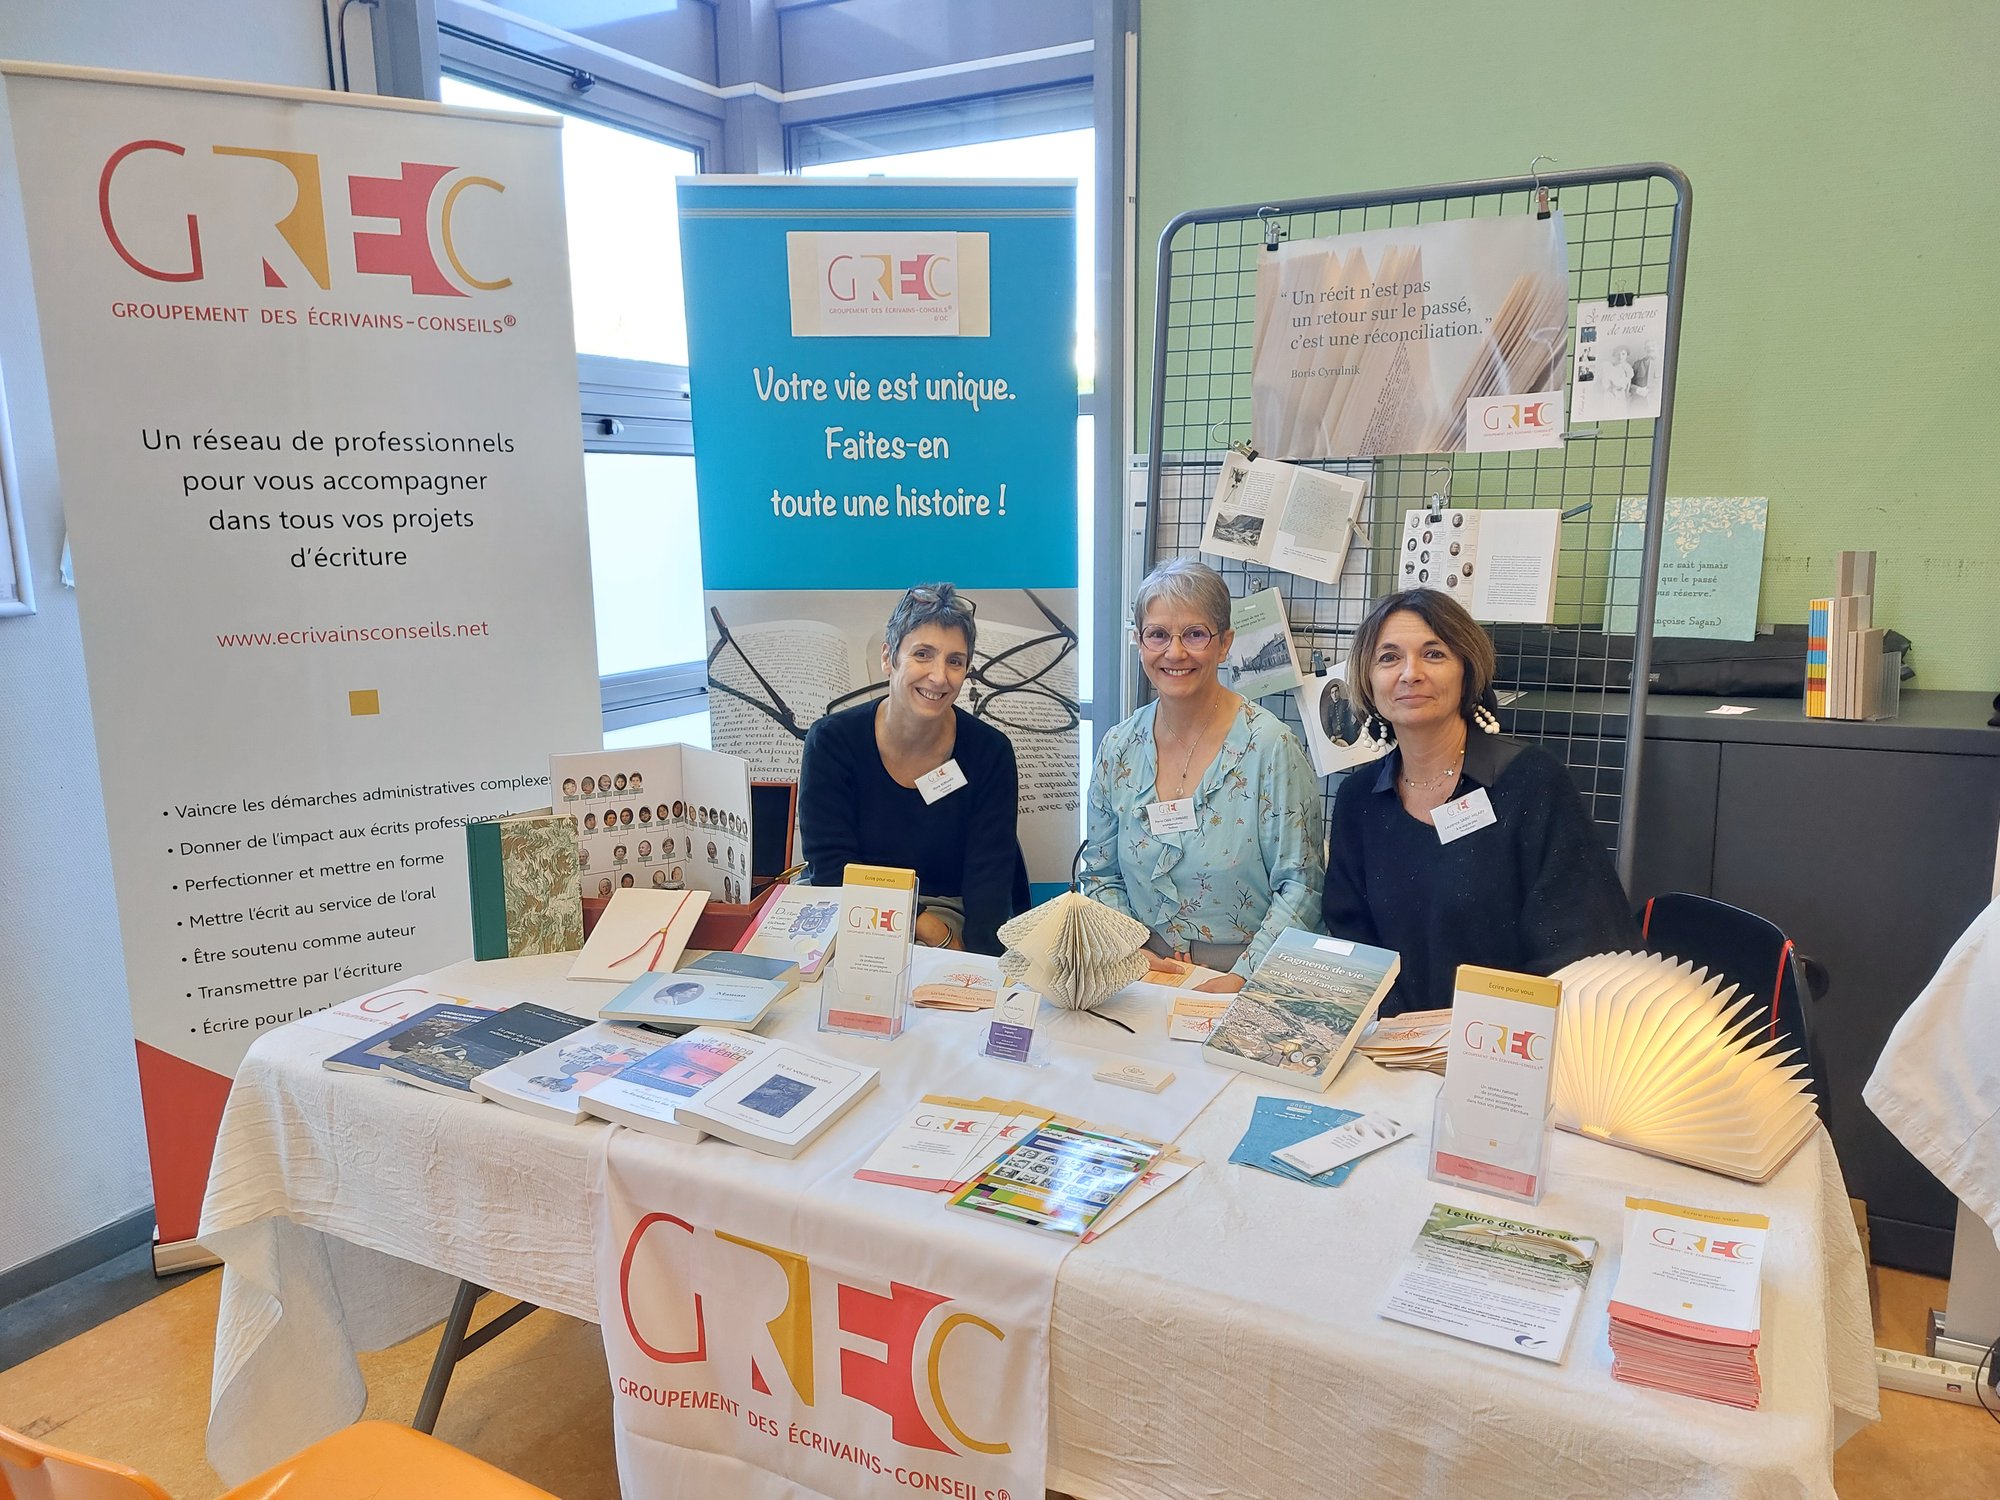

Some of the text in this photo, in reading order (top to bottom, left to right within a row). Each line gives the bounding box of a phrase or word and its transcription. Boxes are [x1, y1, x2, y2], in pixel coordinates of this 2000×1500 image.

[99, 139, 513, 298] GREC
[827, 254, 952, 302] GREC
[1292, 290, 1315, 305] Un
[1319, 286, 1355, 303] récit
[1359, 282, 1398, 299] n'est
[1402, 280, 1431, 297] pas
[111, 302, 249, 324] GROUPEMENT
[261, 309, 298, 325] DES
[828, 307, 868, 315] GROUPEMENT
[1291, 296, 1472, 328] un retour sur le passé,
[1617, 307, 1658, 321] souviens
[1290, 334, 1325, 350] c'est
[1328, 333, 1360, 346] une
[1622, 324, 1646, 335] nous
[1290, 364, 1361, 379] Boris Cyrulnik
[752, 365, 1016, 413] Votre vie est unique.
[1483, 402, 1553, 430] GREC
[142, 427, 515, 457] Un réseau de professionnels
[823, 425, 950, 461] Faites-en
[183, 473, 488, 496] pour vous accompagner
[769, 483, 1008, 518] toute une histoire !
[209, 507, 475, 533] dans tous vos projets
[290, 546, 408, 568] d'écriture
[1676, 561, 1695, 569] sait
[1696, 561, 1729, 572] jamais
[1661, 572, 1718, 586] que le passé
[216, 620, 489, 648] www.ecrivainsconseils.net
[1688, 616, 1722, 629] Sagan)
[175, 802, 238, 819] Vaincre
[243, 798, 265, 813] les
[271, 790, 357, 810] démarches
[362, 779, 476, 802] administratives
[180, 838, 242, 856] Donner
[247, 834, 268, 849] de
[273, 828, 334, 847] l'impact
[339, 826, 366, 840] aux
[370, 818, 410, 836] écrits
[185, 852, 445, 893] Perfectionner et mettre en forme
[189, 886, 437, 929] Mettre l'écrit au service de l'oral
[848, 905, 904, 932] GREC
[194, 924, 417, 964] Être soutenu comme auteur
[198, 960, 403, 1000] Transmettre par l'écriture
[1277, 952, 1365, 980] Fragments de vie
[1280, 971, 1313, 984] Algérie
[1312, 979, 1353, 995] française
[203, 1018, 250, 1035] Écrire
[255, 1010, 294, 1030] pour
[1464, 1020, 1547, 1062] GREC
[915, 1114, 987, 1134] GREC
[1446, 1208, 1580, 1243] Le livre de votre vie
[1652, 1227, 1756, 1260] GREC
[619, 1211, 1012, 1458] GREC
[618, 1376, 740, 1417] GROUPEMENT
[747, 1410, 779, 1437] DES
